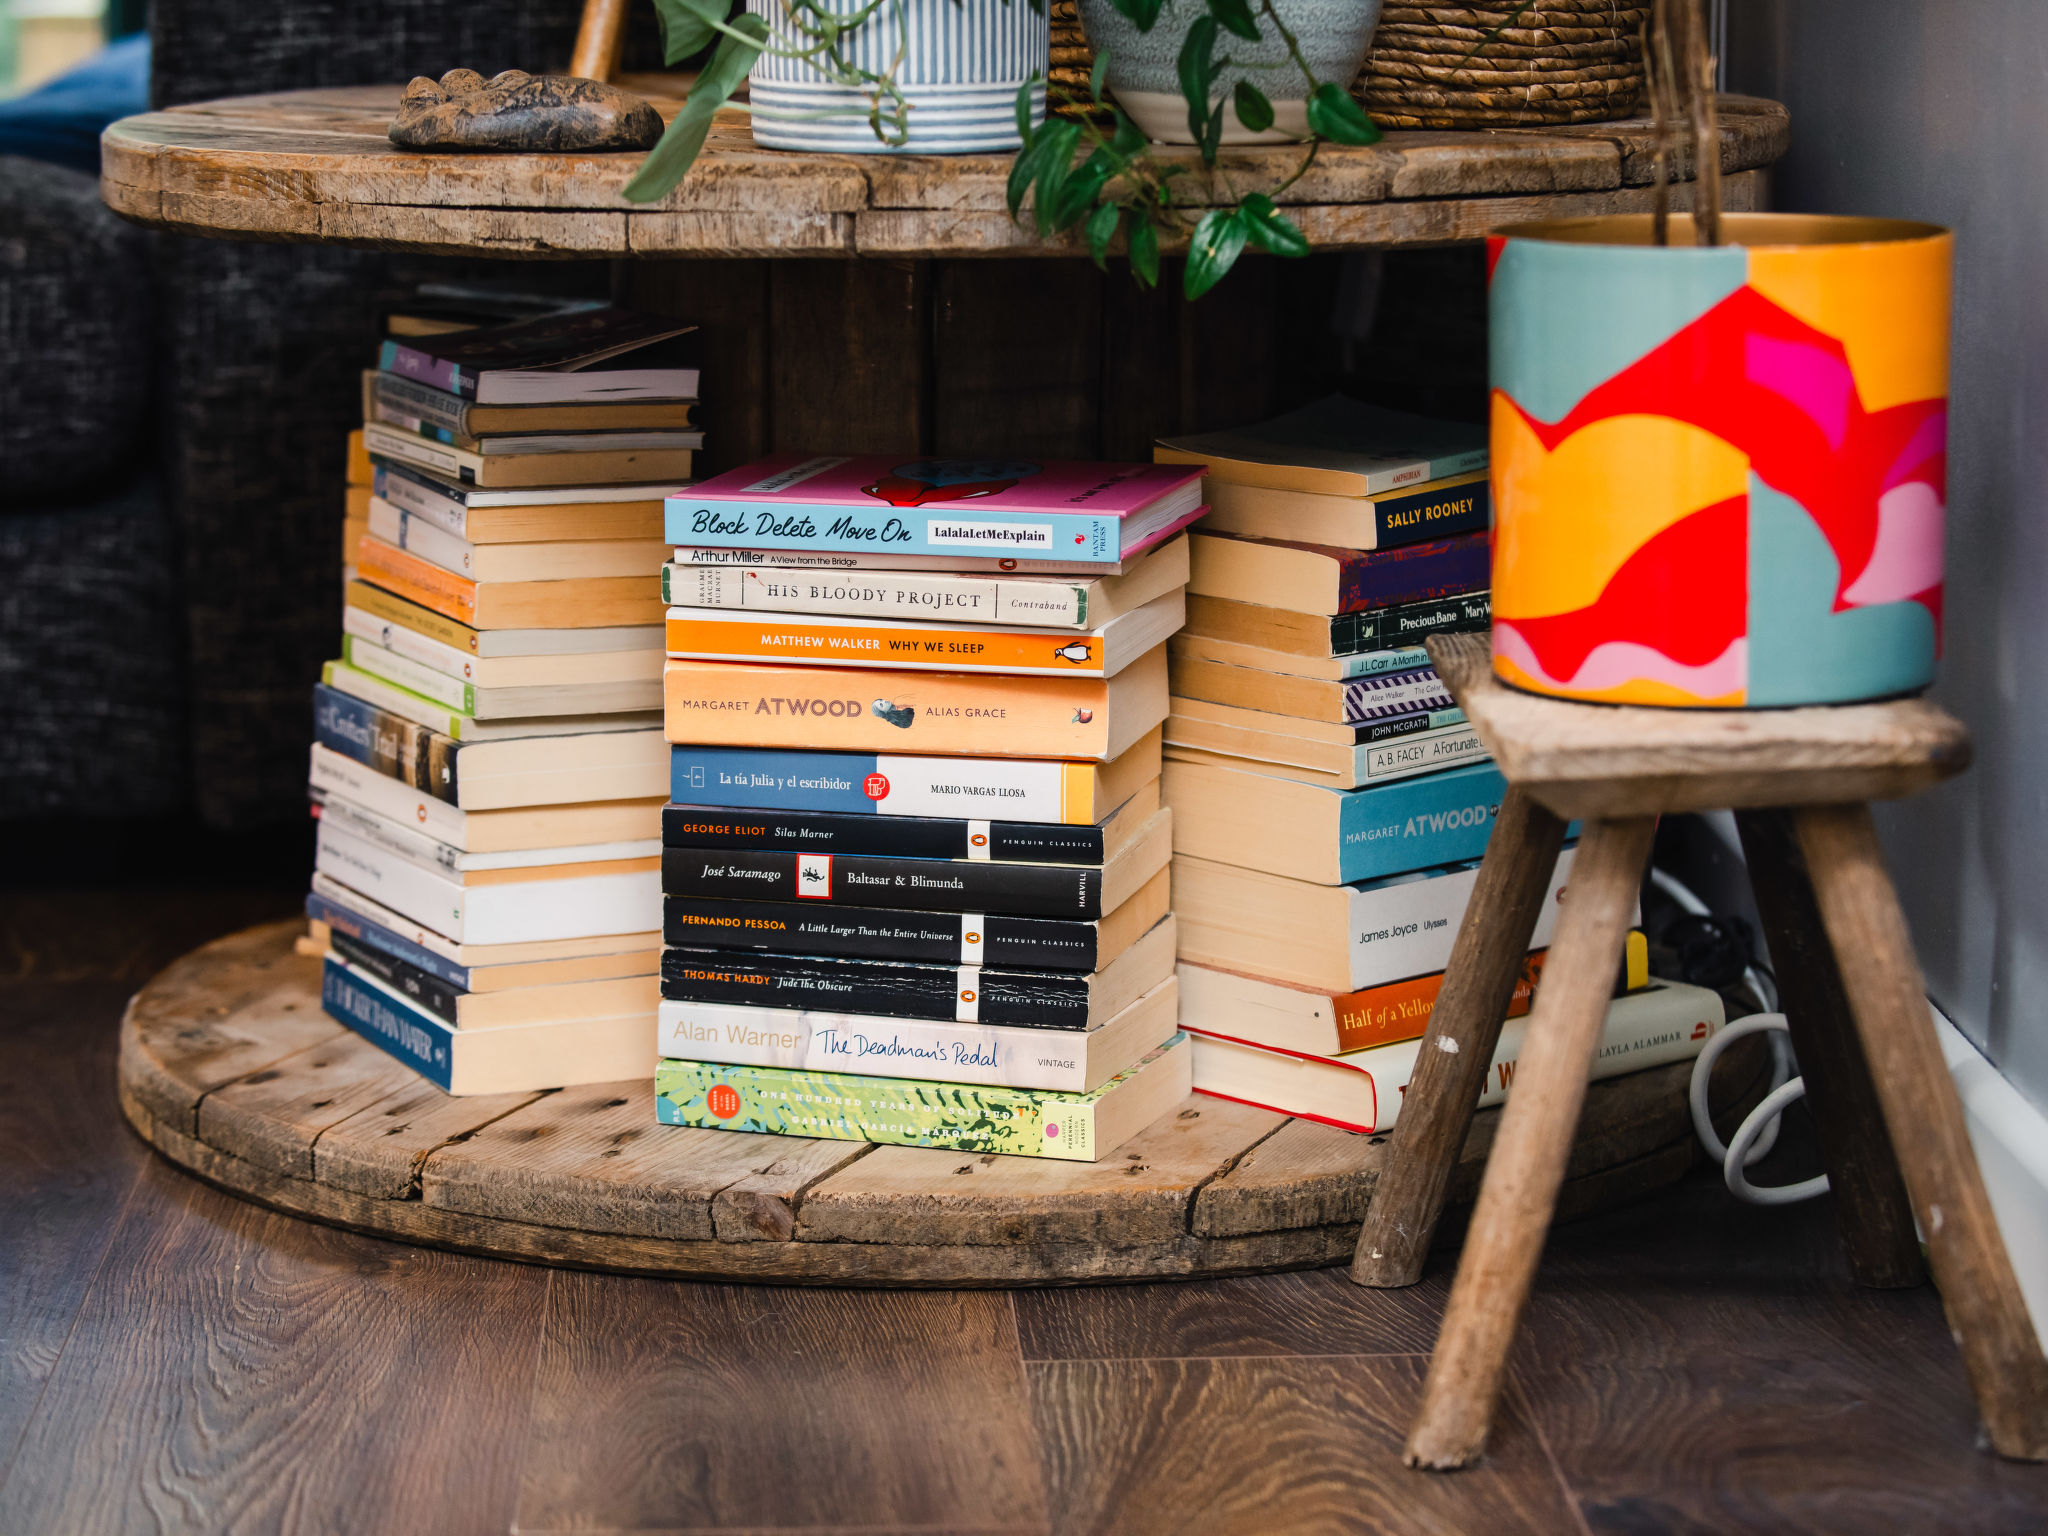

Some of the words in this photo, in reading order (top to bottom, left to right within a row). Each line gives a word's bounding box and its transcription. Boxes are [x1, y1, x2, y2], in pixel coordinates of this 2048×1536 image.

[1392, 469, 1421, 484] AMPHIBIAN
[1387, 508, 1421, 529] SALLY
[1426, 498, 1473, 520] ROONEY
[691, 509, 749, 534] Block
[755, 512, 817, 538] Delete
[825, 515, 878, 541] Move
[881, 518, 912, 542] On
[934, 526, 1046, 544] LalalaLetMeExplain
[691, 550, 729, 562] Arthur
[732, 550, 765, 563] Miller
[776, 556, 797, 564] View
[797, 556, 815, 565] from
[816, 556, 831, 565] the
[831, 557, 857, 567] Bridge
[767, 584, 799, 598] HIS
[810, 586, 887, 602] BLOODY
[896, 590, 981, 610] PROJECT
[1011, 599, 1068, 611] Contraband
[1465, 605, 1484, 619] Mary
[1400, 613, 1436, 631] Precious
[1436, 611, 1457, 624] Bane
[761, 634, 824, 648] MATTHEW
[828, 637, 880, 650] WALKER
[889, 640, 919, 652] WHY
[924, 641, 944, 653] WE
[948, 642, 985, 654] SLEEP
[1397, 653, 1420, 666] Month
[1370, 694, 1384, 703] Alice
[1385, 690, 1405, 700] Walker
[1414, 687, 1425, 695] The
[683, 699, 750, 711] MARGARET
[754, 697, 863, 718] ATWOOD
[926, 706, 960, 717] ALIAS
[965, 707, 1007, 719] GRACE
[1371, 725, 1391, 739] JOHN
[1393, 717, 1428, 733] MCGRATH
[1397, 746, 1425, 763] FACEY
[1433, 742, 1441, 756] A
[1441, 737, 1479, 755] Fortunate
[719, 772, 732, 785] La
[734, 772, 748, 786] tía
[750, 773, 775, 787] Julia
[777, 778, 784, 790] y
[786, 775, 797, 788] el
[799, 775, 851, 791] escribidor
[931, 783, 961, 795] MARIO
[962, 785, 996, 797] VARGAS
[999, 787, 1026, 798] LLOSA
[683, 823, 730, 835] GEORGE
[735, 826, 766, 836] ELIOT
[774, 827, 797, 838] Silas
[799, 828, 834, 839] Marner
[1346, 825, 1400, 844] MARGARET
[1403, 805, 1488, 839] ATWOOD
[701, 864, 725, 879] José
[727, 866, 781, 883] Saramago
[847, 872, 890, 886] Baltasar
[895, 876, 906, 886] &
[910, 875, 964, 889] Blimunda
[1079, 872, 1087, 908] HARVILL
[682, 915, 741, 928] FERNANDO
[745, 919, 786, 931] PESSOA
[1423, 918, 1448, 931] Ulysses
[799, 923, 805, 932] A
[807, 923, 828, 933] Little
[830, 924, 855, 937] Larger
[857, 926, 878, 936] Than
[879, 928, 891, 937] the
[894, 929, 918, 939] Entire
[920, 930, 954, 941] Universe
[1359, 927, 1389, 944] James
[1390, 922, 1418, 938] Joyce
[1042, 939, 1085, 947] CLASSICS
[683, 969, 731, 982] THOMAS
[734, 974, 770, 986] HARDY
[777, 977, 798, 989] Jude
[800, 978, 815, 989] The
[817, 980, 853, 992] Obscure
[991, 996, 1031, 1004] PENGUIN
[1036, 999, 1079, 1008] CLASSICS
[1343, 1007, 1372, 1030] Half
[1376, 1006, 1388, 1029] of
[1390, 1010, 1398, 1021] a
[673, 1020, 718, 1043] Alan
[727, 1024, 802, 1049] Warner
[816, 1029, 852, 1055] The
[853, 1033, 948, 1062] Deadman's
[951, 1041, 998, 1068] Pedal
[1599, 1044, 1629, 1058] LAYLA
[1633, 1031, 1683, 1050] ALAMMAR
[1037, 1058, 1076, 1069] VINTAGE
[760, 1090, 787, 1100] ONE
[795, 1093, 862, 1106] HUNDRED
[870, 1100, 915, 1111] YEARS
[923, 1105, 940, 1113] OF
[948, 1107, 1020, 1120] SOLITUDE
[791, 1116, 852, 1128] GABRIEL
